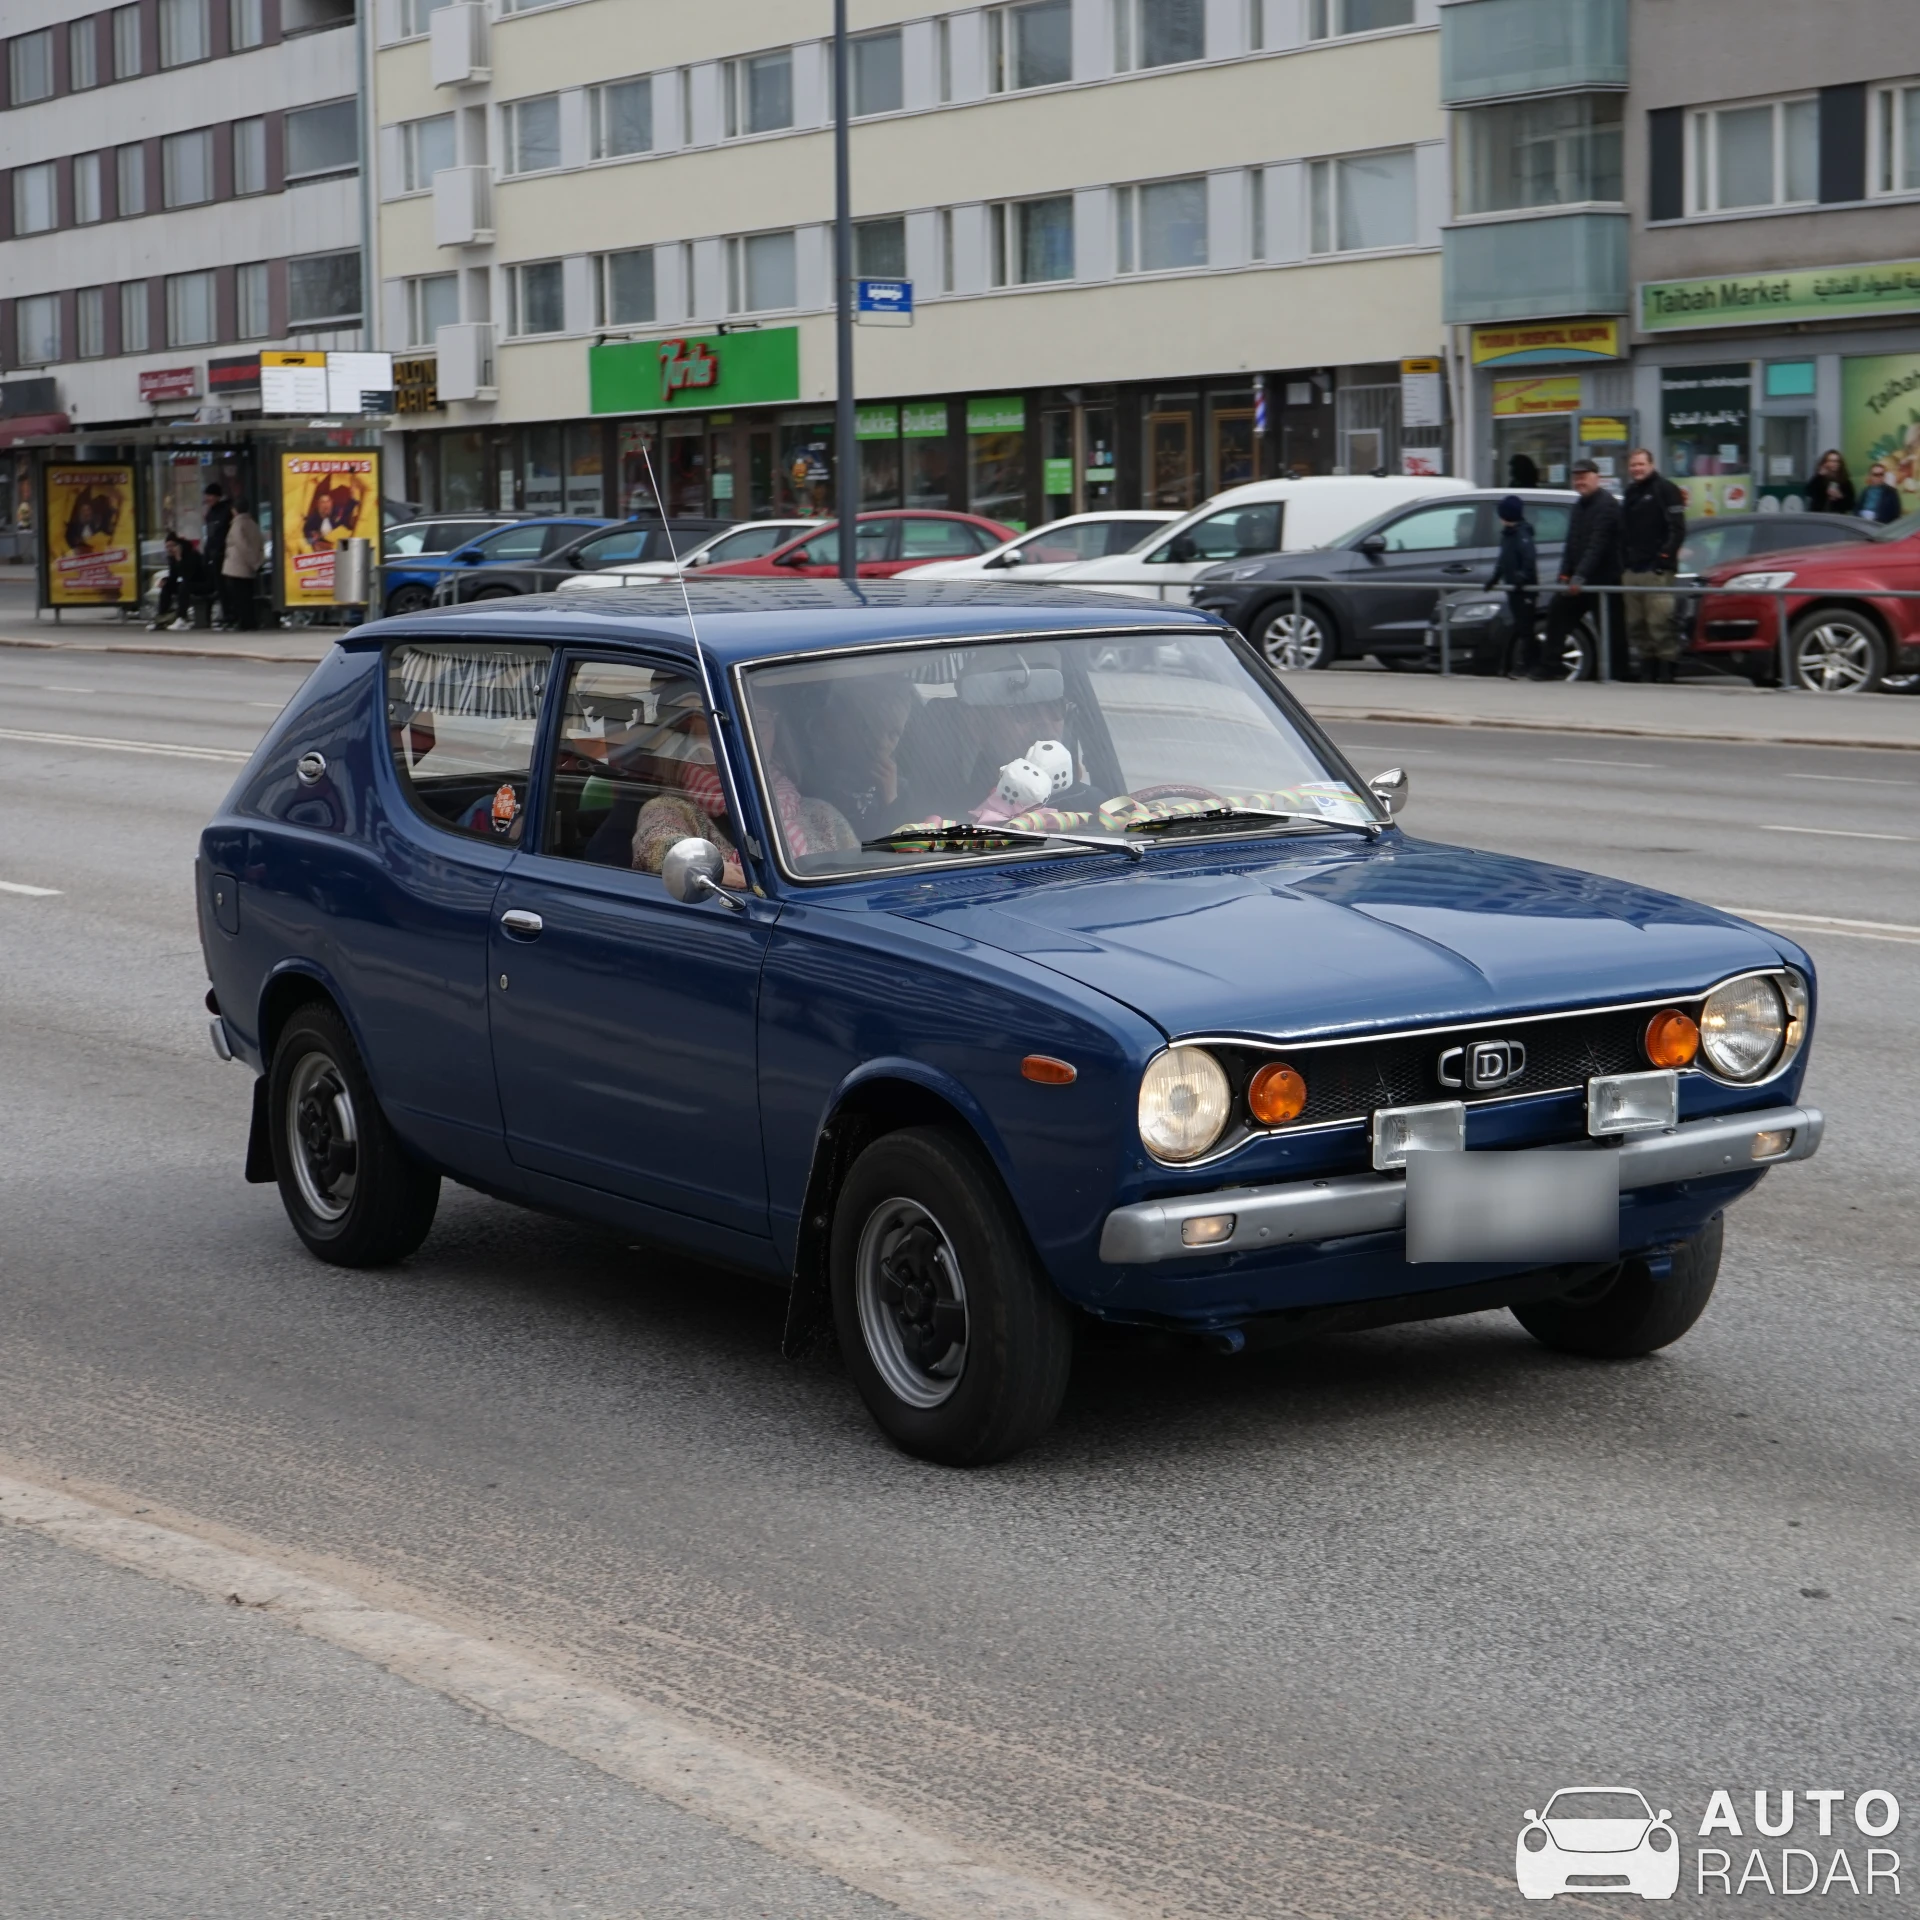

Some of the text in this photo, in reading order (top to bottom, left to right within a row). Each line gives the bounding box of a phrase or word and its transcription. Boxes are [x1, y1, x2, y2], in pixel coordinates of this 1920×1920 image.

[1652, 279, 1791, 315] Taibah Market
[301, 461, 371, 473] BAUHAUS
